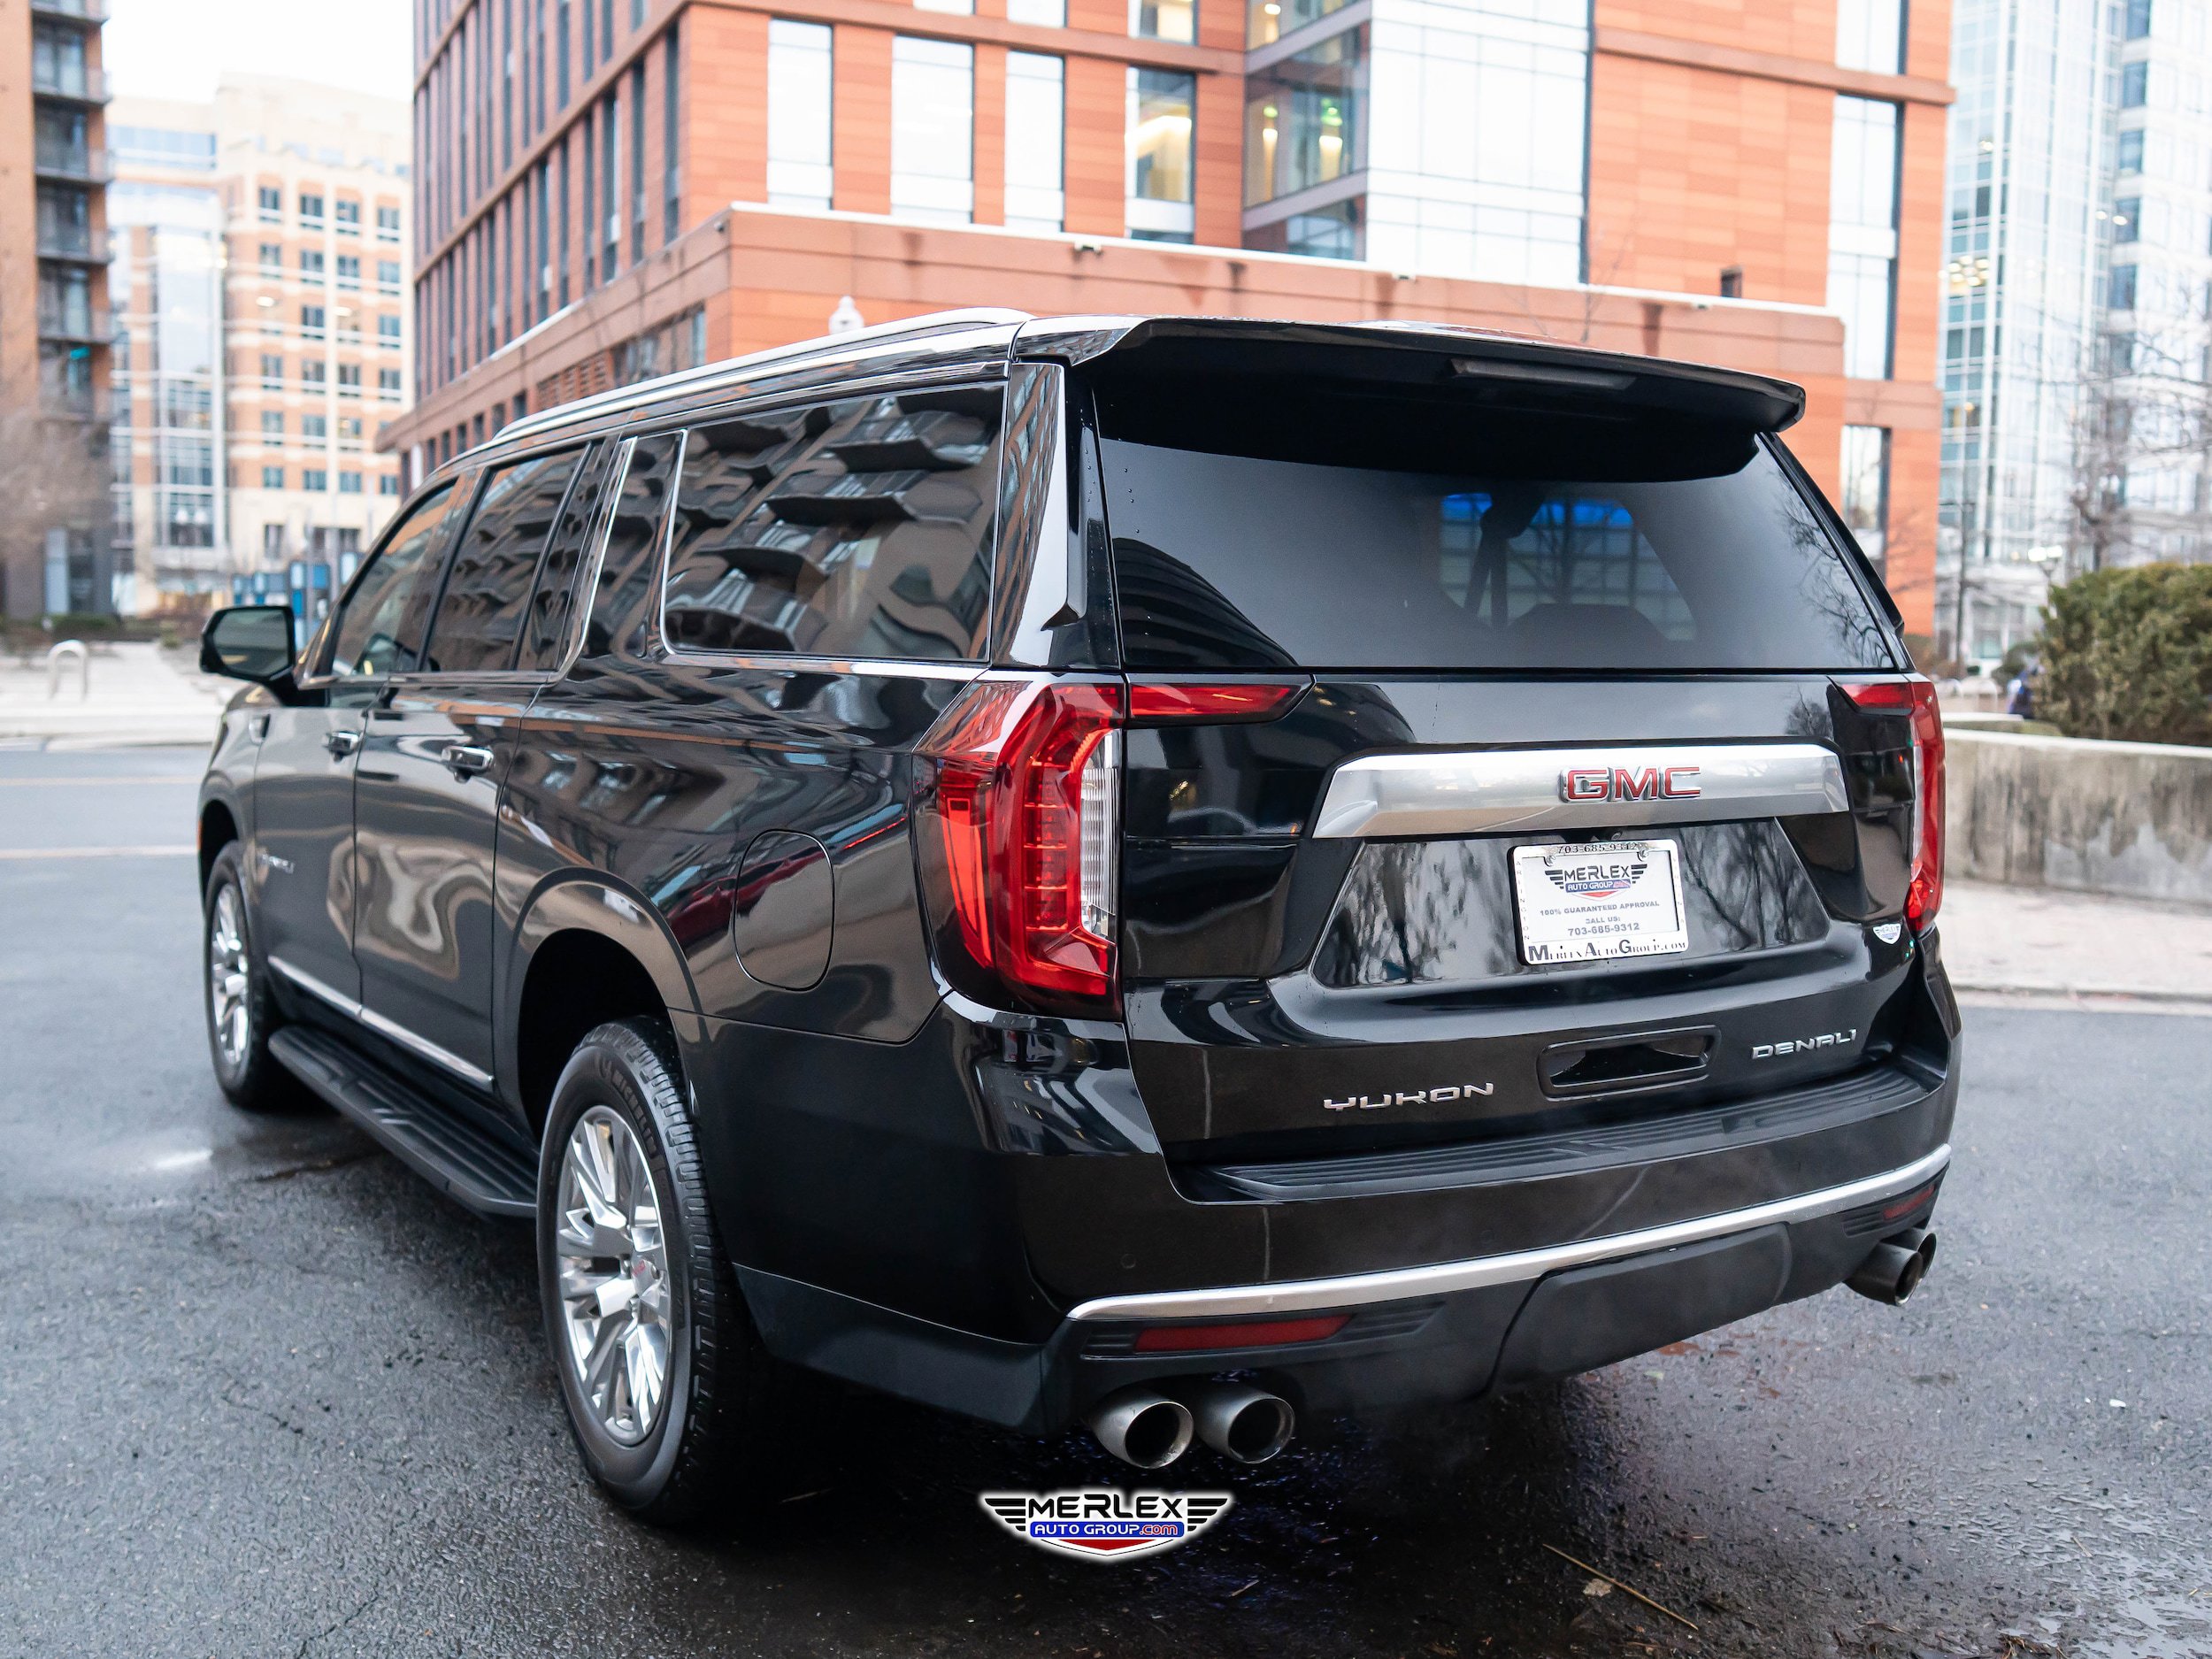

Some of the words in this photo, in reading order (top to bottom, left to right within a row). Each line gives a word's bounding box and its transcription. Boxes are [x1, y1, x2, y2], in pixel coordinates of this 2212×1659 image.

[1559, 766, 1701, 803] GMC
[1557, 842, 1637, 855] 703-685-9312
[1564, 864, 1631, 882] MERLEX
[1567, 882, 1588, 891] AUTO
[1540, 908, 1562, 917] 100%
[1564, 904, 1617, 914] GUARANTEED
[1620, 901, 1660, 910] APPROVAL
[1568, 923, 1640, 937] 703-685-9312
[1752, 1028, 1856, 1060] DENALI
[1324, 1082, 1494, 1111] YUKON
[611, 1069, 657, 1156] MICHELIN
